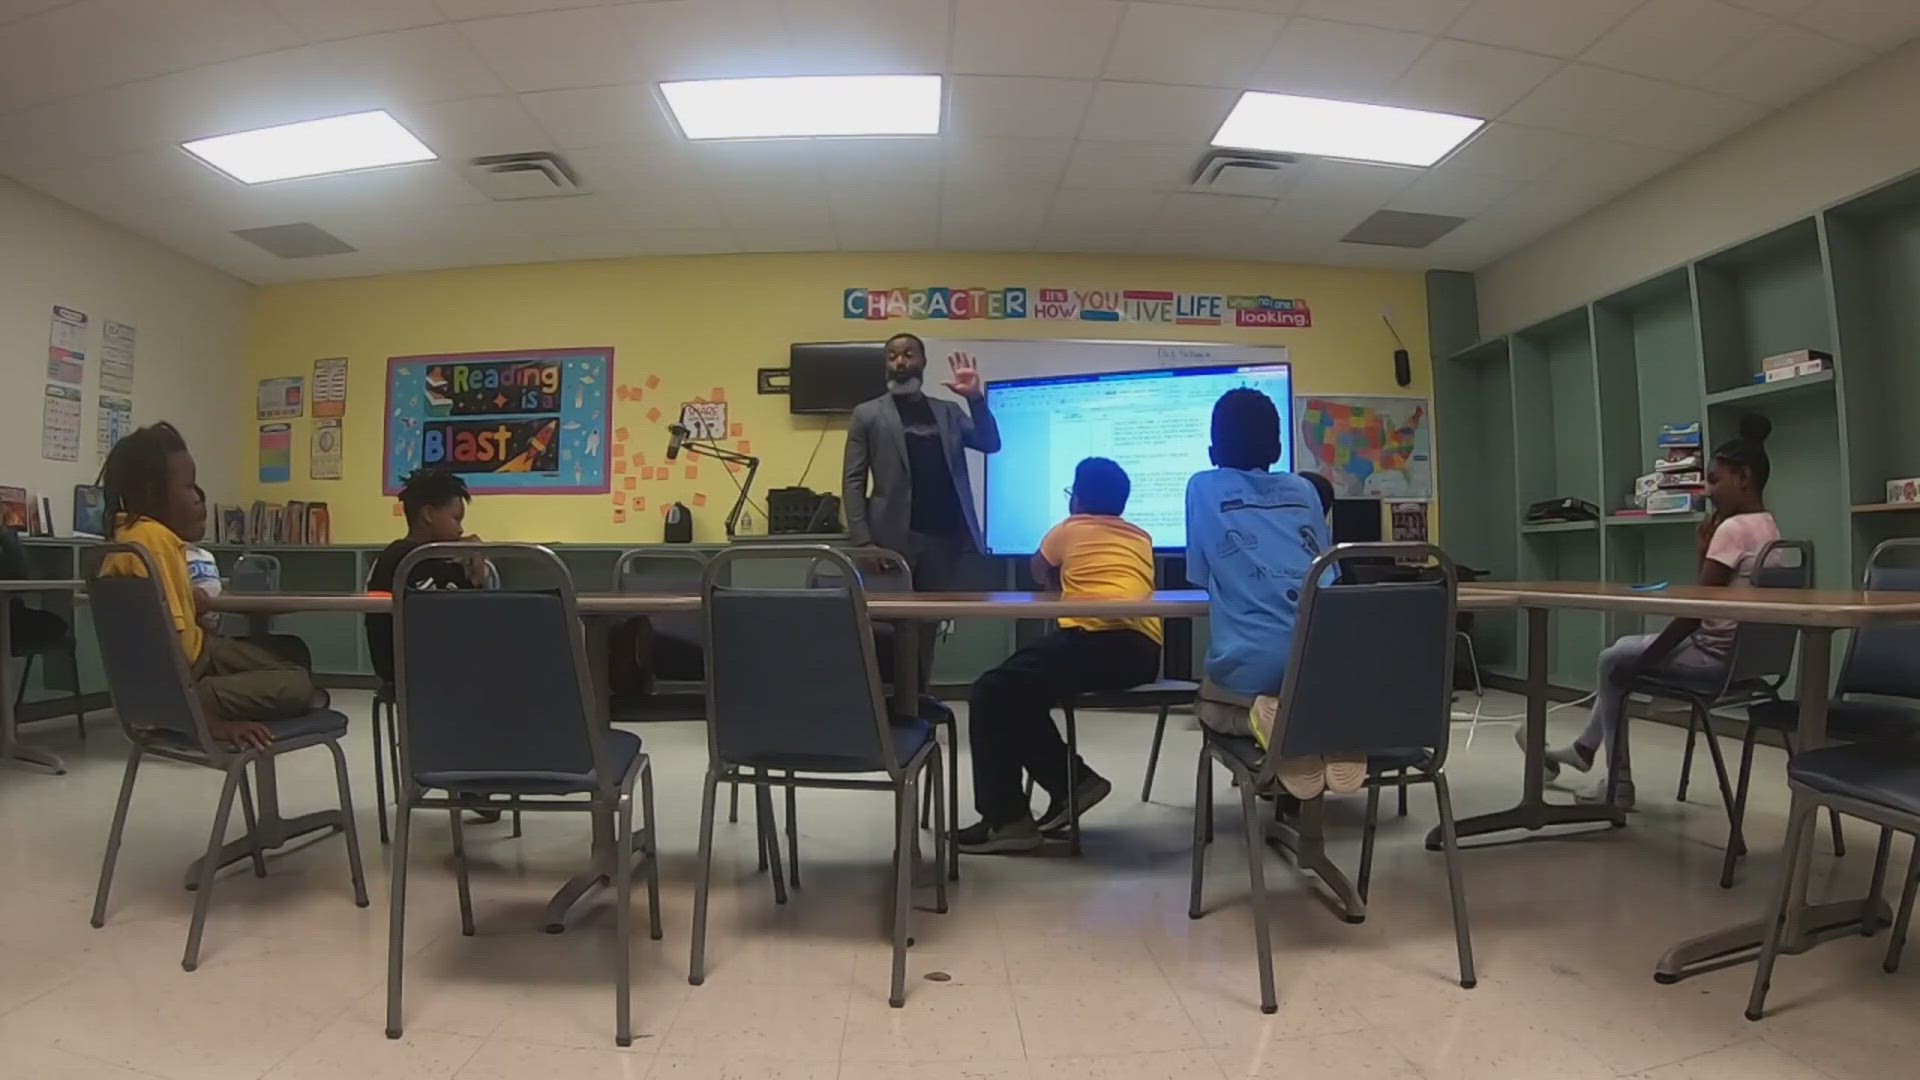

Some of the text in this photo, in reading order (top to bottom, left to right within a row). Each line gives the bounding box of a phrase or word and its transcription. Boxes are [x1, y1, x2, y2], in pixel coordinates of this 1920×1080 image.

[846, 290, 1025, 317] CHARACTER
[1034, 303, 1076, 319] HOW
[1074, 290, 1222, 322] YOU LIVE LIFE
[453, 365, 559, 394] Reading
[521, 388, 554, 409] is a
[424, 424, 512, 463] Blast
